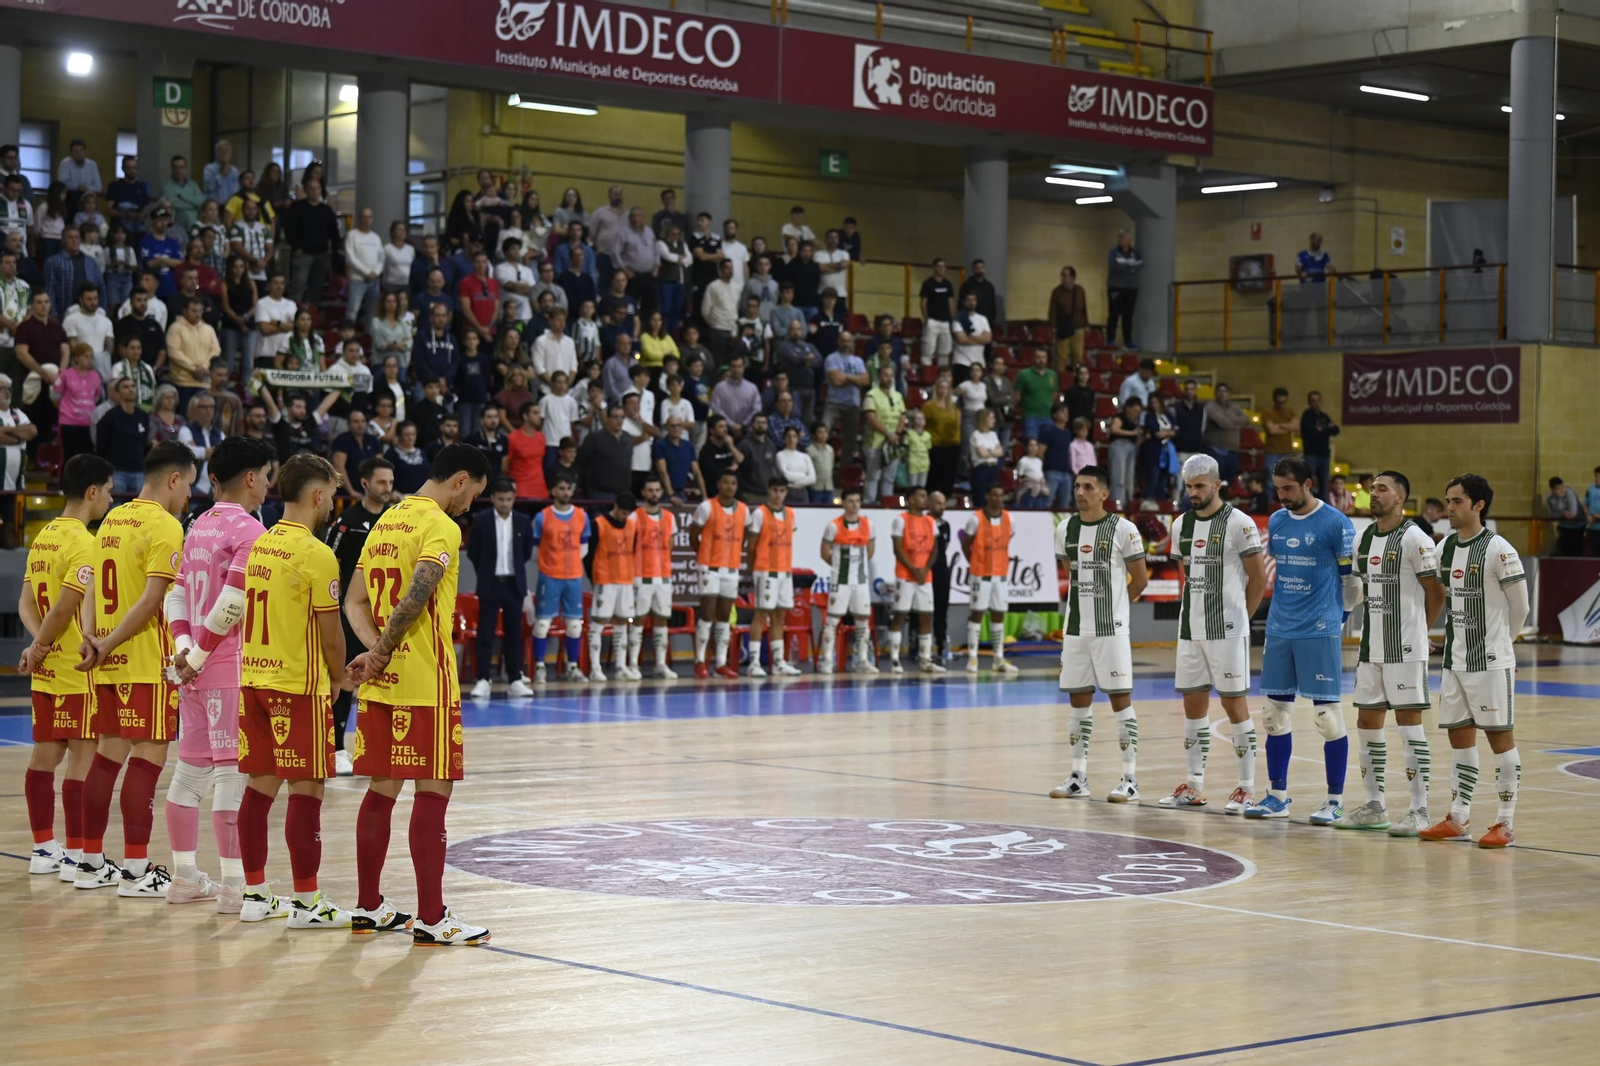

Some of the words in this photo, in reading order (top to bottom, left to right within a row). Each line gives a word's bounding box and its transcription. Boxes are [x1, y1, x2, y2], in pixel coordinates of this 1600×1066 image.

[237, 0, 256, 19] DE
[554, 3, 742, 68] IMDECO
[495, 50, 547, 70] Instituto
[550, 57, 611, 79] Municipal
[613, 66, 630, 80] de
[632, 67, 687, 85] Deportes
[689, 73, 739, 93] Córdoba
[908, 65, 996, 95] Diputación
[165, 82, 182, 104] D
[908, 89, 930, 109] de
[933, 91, 997, 118] Córdoba
[1101, 86, 1208, 129] IMDECO
[1068, 117, 1097, 130] Instituto
[1099, 121, 1133, 136] Municipal
[1134, 126, 1144, 136] de
[1145, 127, 1176, 141] Deportes
[828, 154, 841, 173] E
[314, 374, 344, 382] FUTSAL
[1385, 364, 1514, 398] IMDECO
[1349, 404, 1381, 414] Instituto
[1382, 403, 1421, 414] Municipal
[1423, 402, 1434, 413] de
[1435, 402, 1473, 413] Deportes
[1475, 400, 1511, 412] Córdoba
[102, 536, 121, 549] DANIEL
[37, 582, 51, 621] 6
[102, 558, 119, 615] 9
[186, 570, 210, 626] 12
[369, 567, 402, 627] 23
[245, 587, 270, 646] 11
